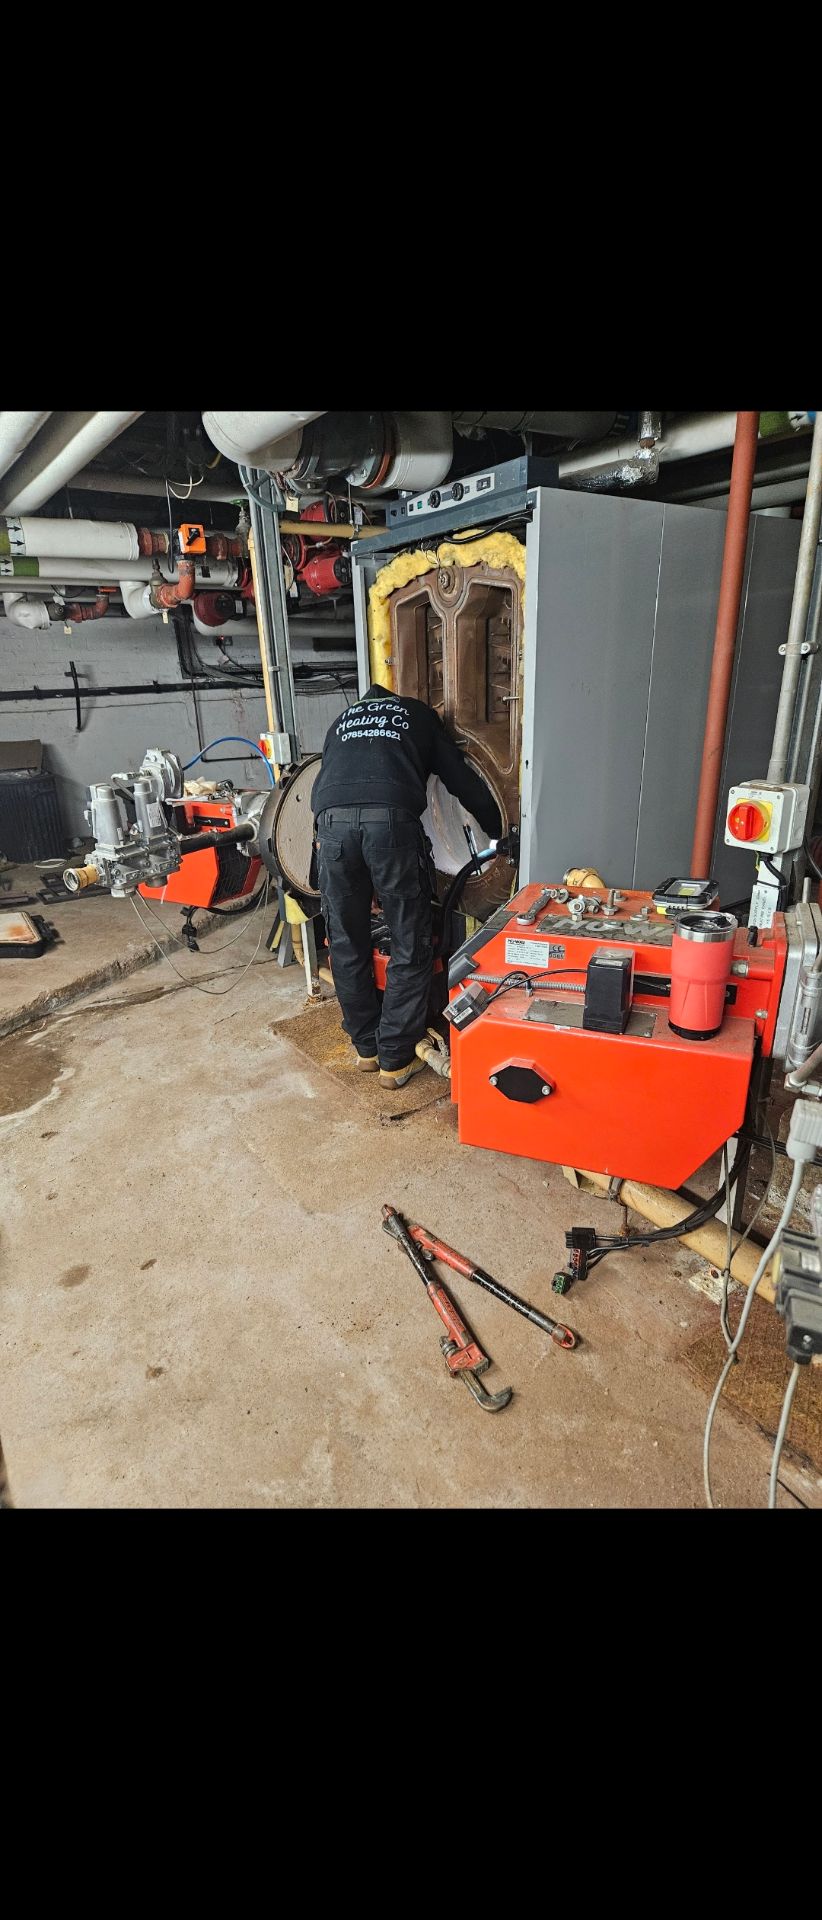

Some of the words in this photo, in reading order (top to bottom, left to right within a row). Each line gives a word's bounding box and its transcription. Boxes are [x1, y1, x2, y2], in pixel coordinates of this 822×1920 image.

[367, 702, 410, 716] Green
[335, 715, 388, 735] Heating
[391, 715, 409, 729] Co
[341, 728, 401, 742] 07854286621
